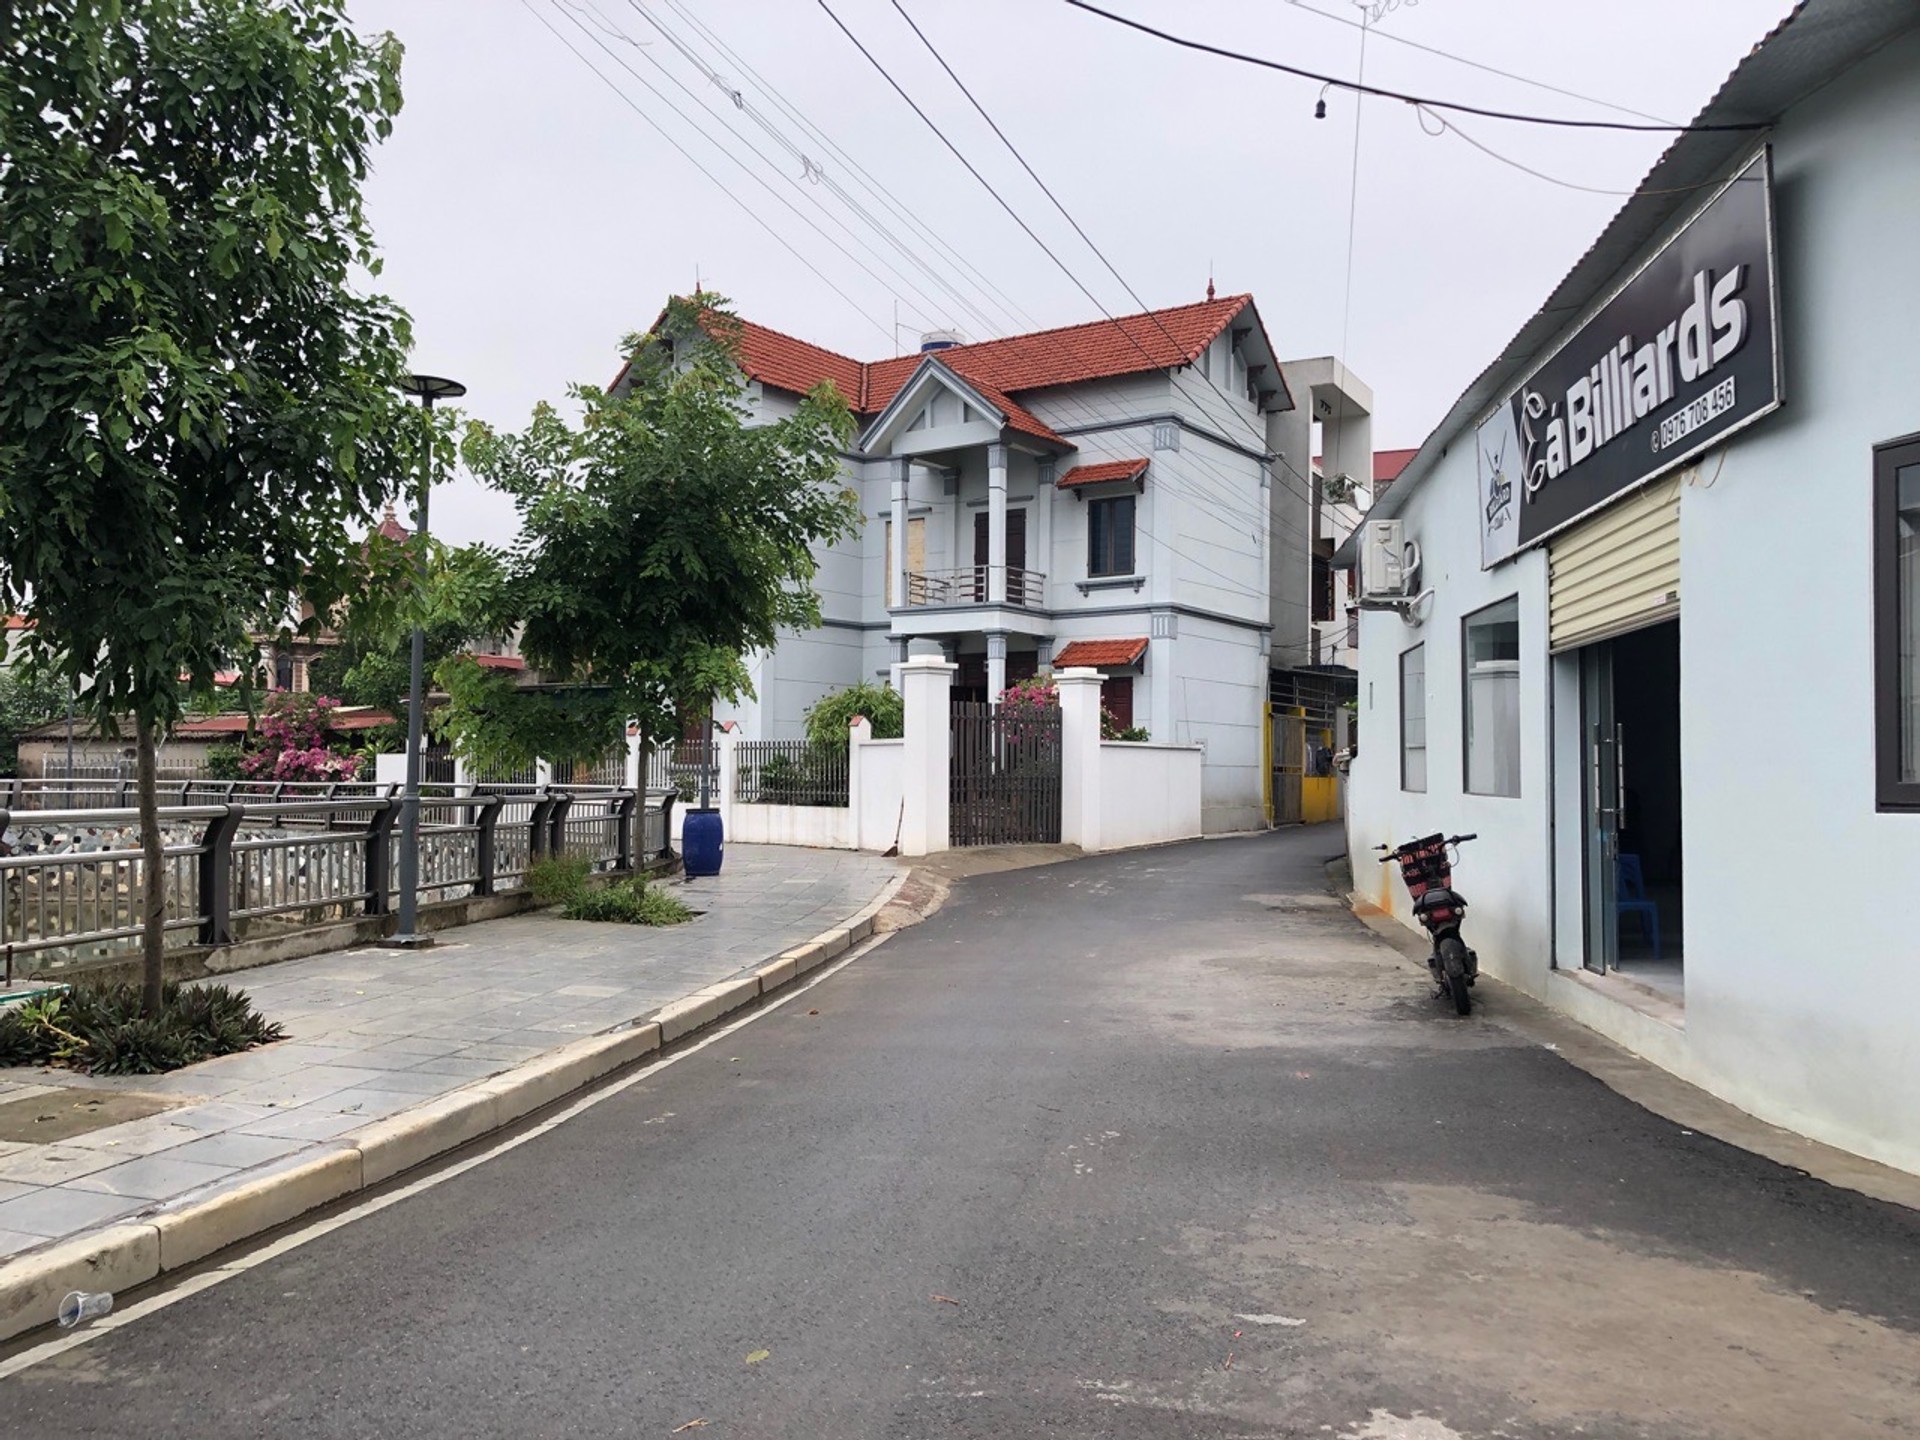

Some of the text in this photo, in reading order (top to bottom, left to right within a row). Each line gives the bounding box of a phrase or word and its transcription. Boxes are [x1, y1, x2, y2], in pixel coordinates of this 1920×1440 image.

[1661, 380, 1733, 446] 0976 708 456
